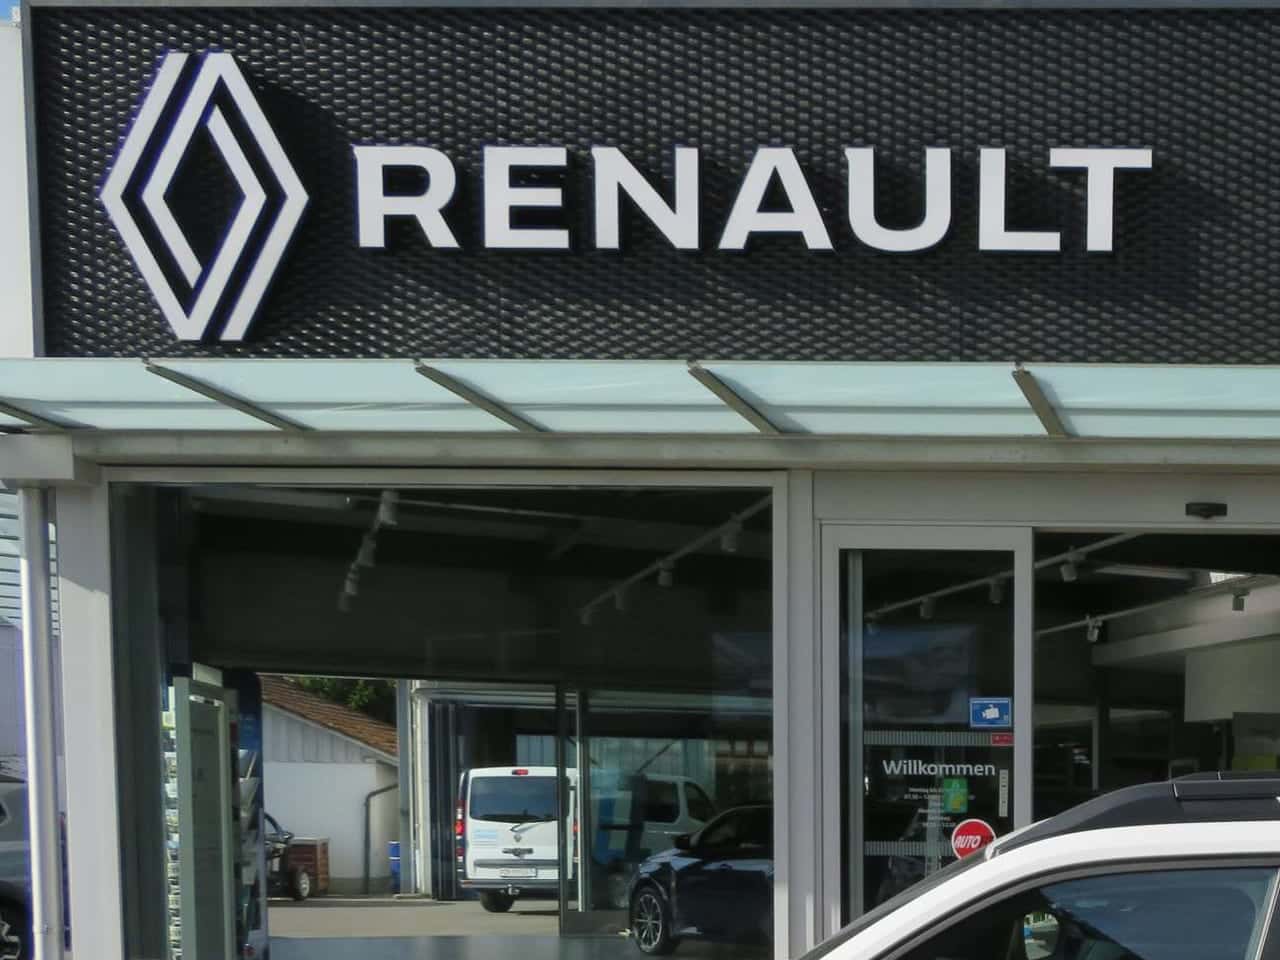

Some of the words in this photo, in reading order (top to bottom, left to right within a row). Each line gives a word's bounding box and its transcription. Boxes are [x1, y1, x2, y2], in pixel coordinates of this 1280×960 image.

[352, 144, 1154, 254] RENAULT
[882, 759, 996, 776] Willkommen
[954, 834, 982, 849] AUTO
